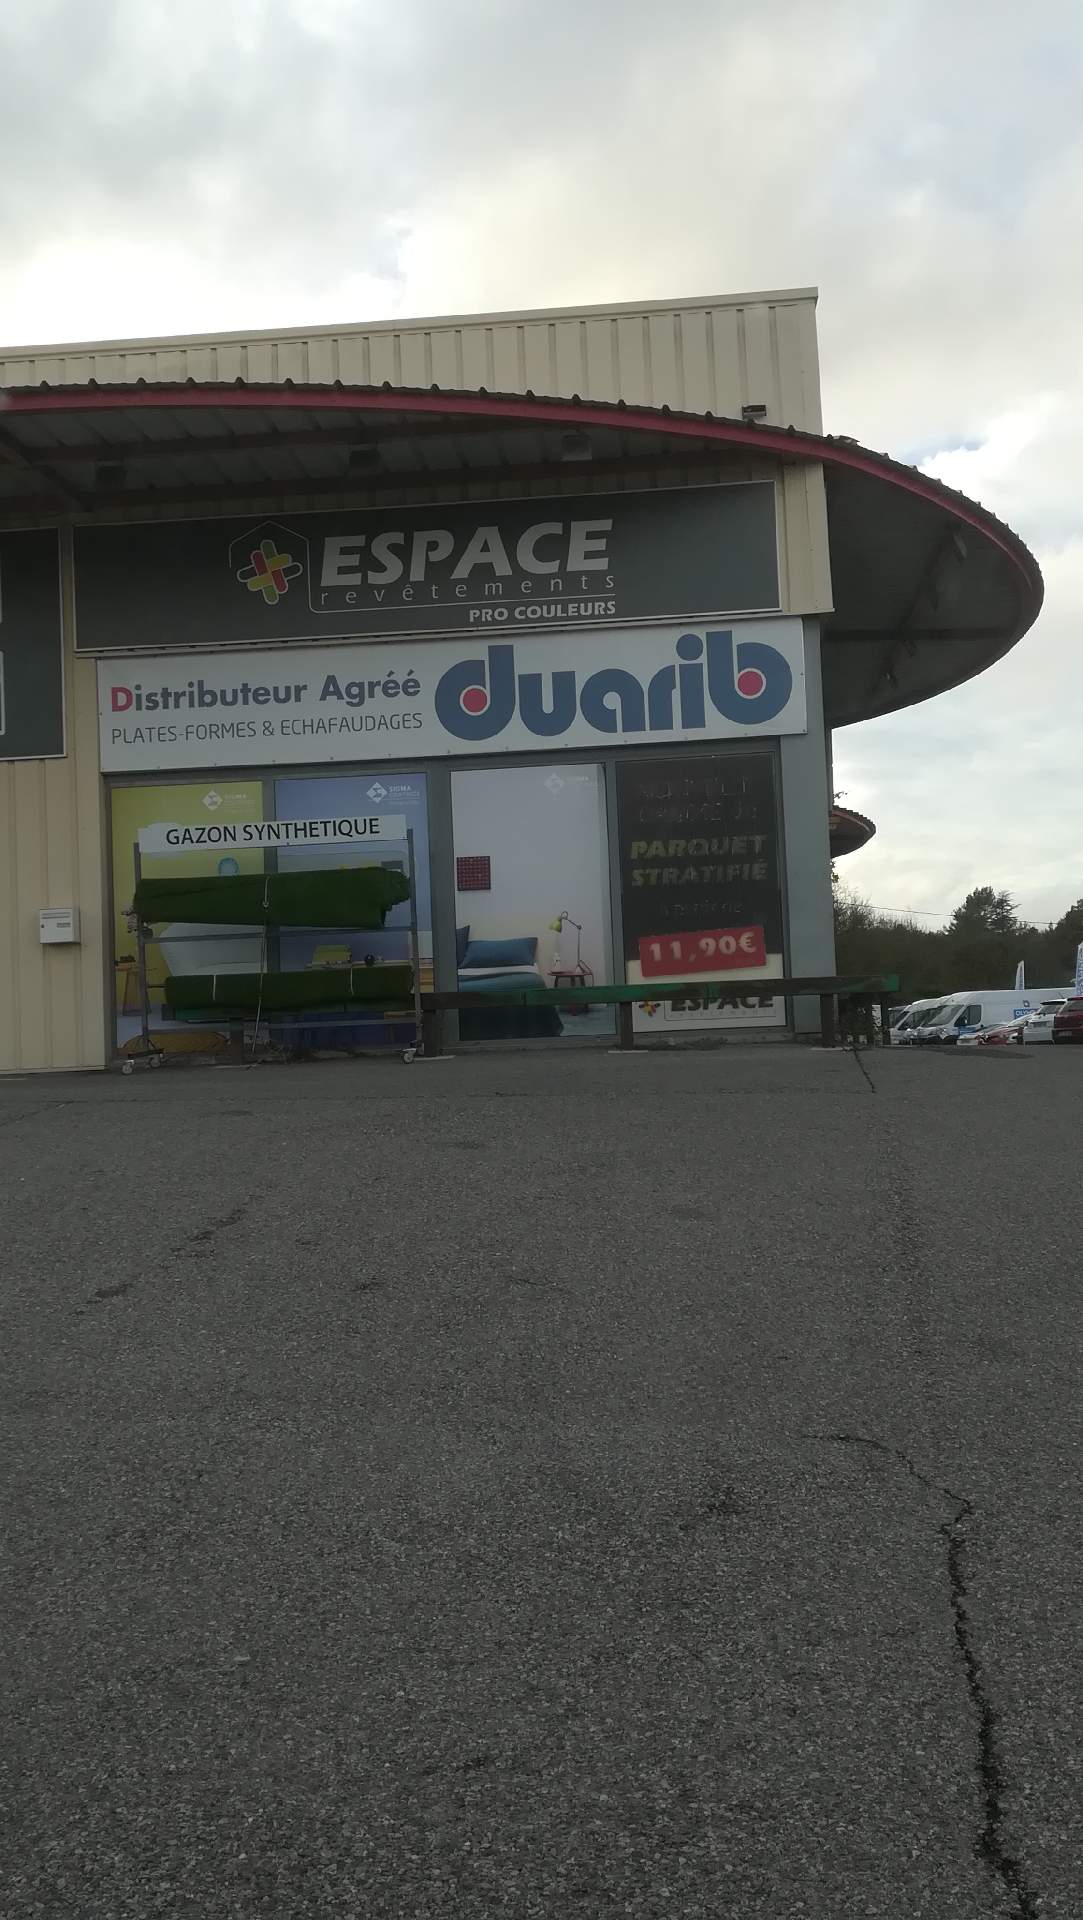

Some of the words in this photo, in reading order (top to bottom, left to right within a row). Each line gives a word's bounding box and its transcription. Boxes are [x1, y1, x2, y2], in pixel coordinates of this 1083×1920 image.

[320, 519, 613, 587] ESPACE
[320, 575, 616, 606] revêtements
[469, 607, 509, 623] PRO
[514, 600, 617, 620] COULEURS
[111, 680, 308, 712] Distributeur
[318, 669, 421, 707] Agréé
[434, 630, 793, 741] duarib
[111, 721, 257, 744] PLATES-FORMES
[262, 720, 275, 736] &
[280, 712, 423, 736] ECHAFAUDAGES
[166, 826, 237, 845] GAZON
[242, 817, 380, 842] SYNTHETIQUE
[630, 835, 768, 859] PARQUET
[650, 931, 757, 962] 11,90€
